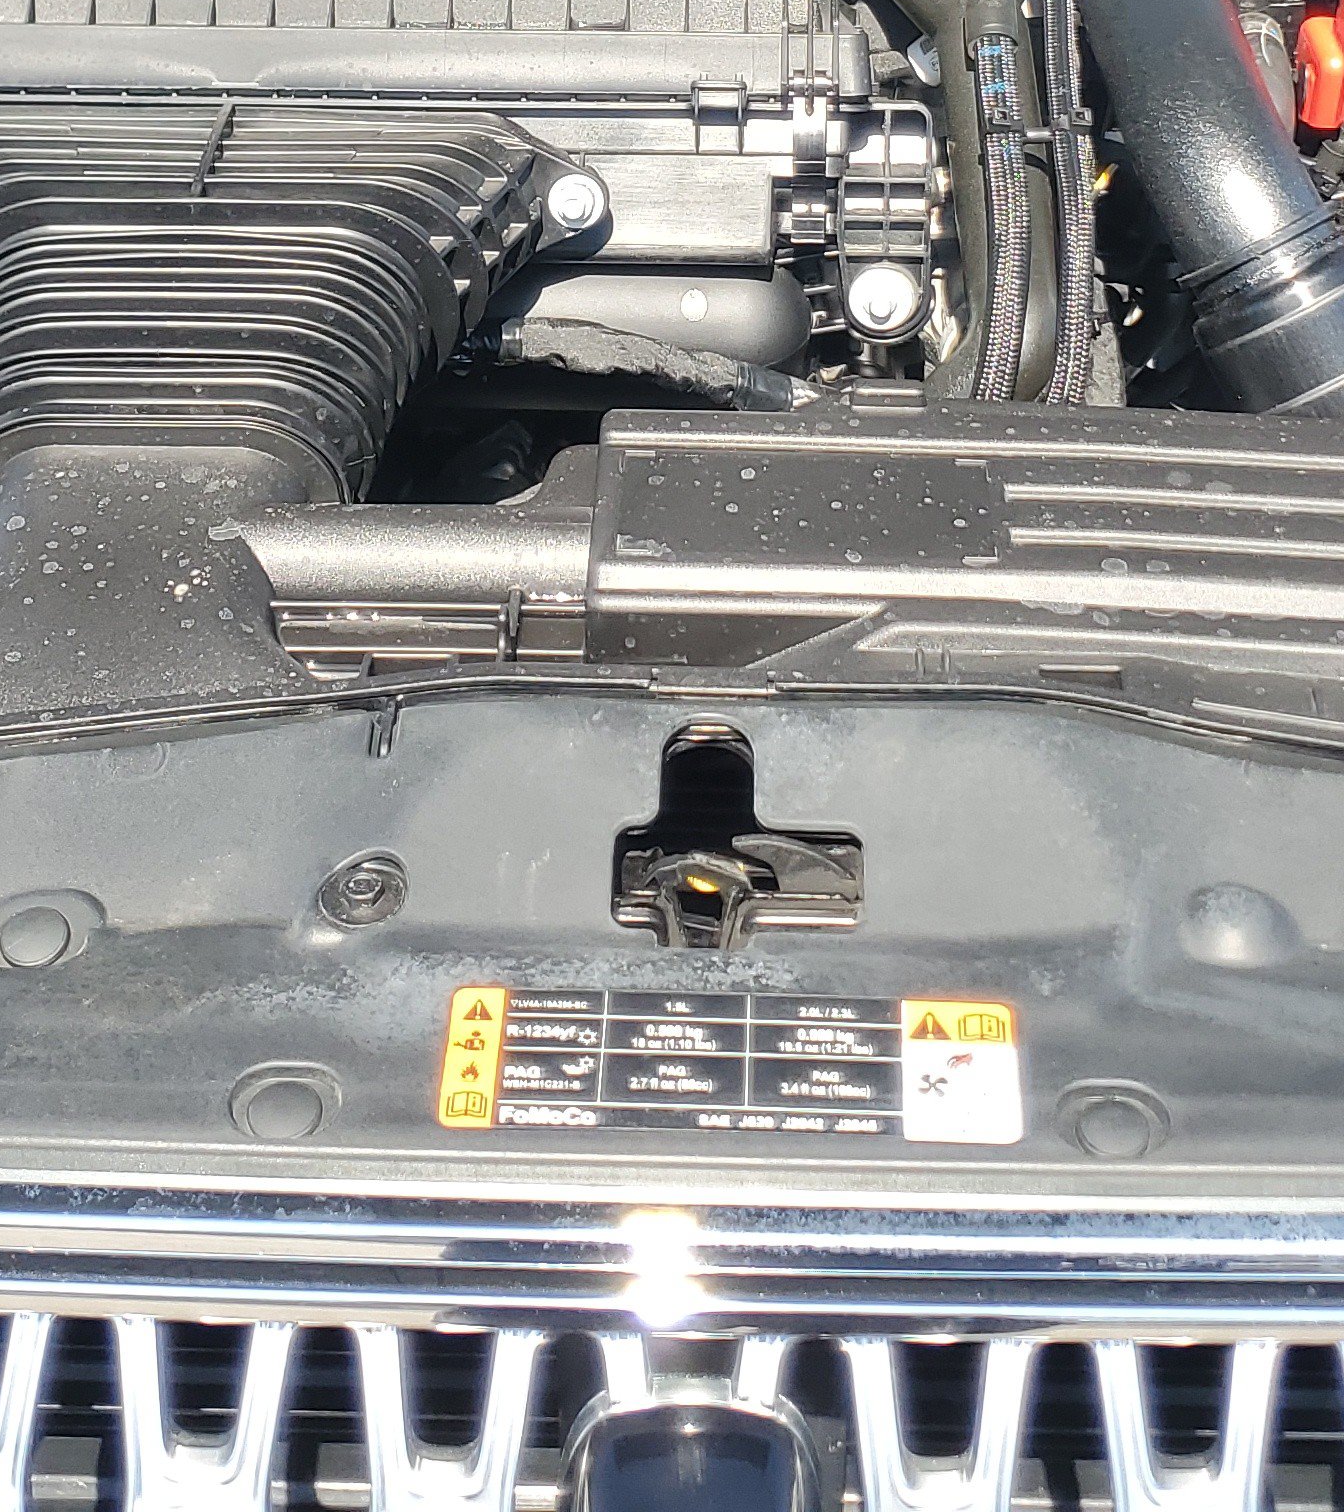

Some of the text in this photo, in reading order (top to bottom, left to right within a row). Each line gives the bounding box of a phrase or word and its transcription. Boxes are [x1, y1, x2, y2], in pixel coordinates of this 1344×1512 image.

[506, 1024, 577, 1042] R-1234yf
[629, 1077, 648, 1090] 2.7
[498, 1105, 597, 1126] FoMoCo
